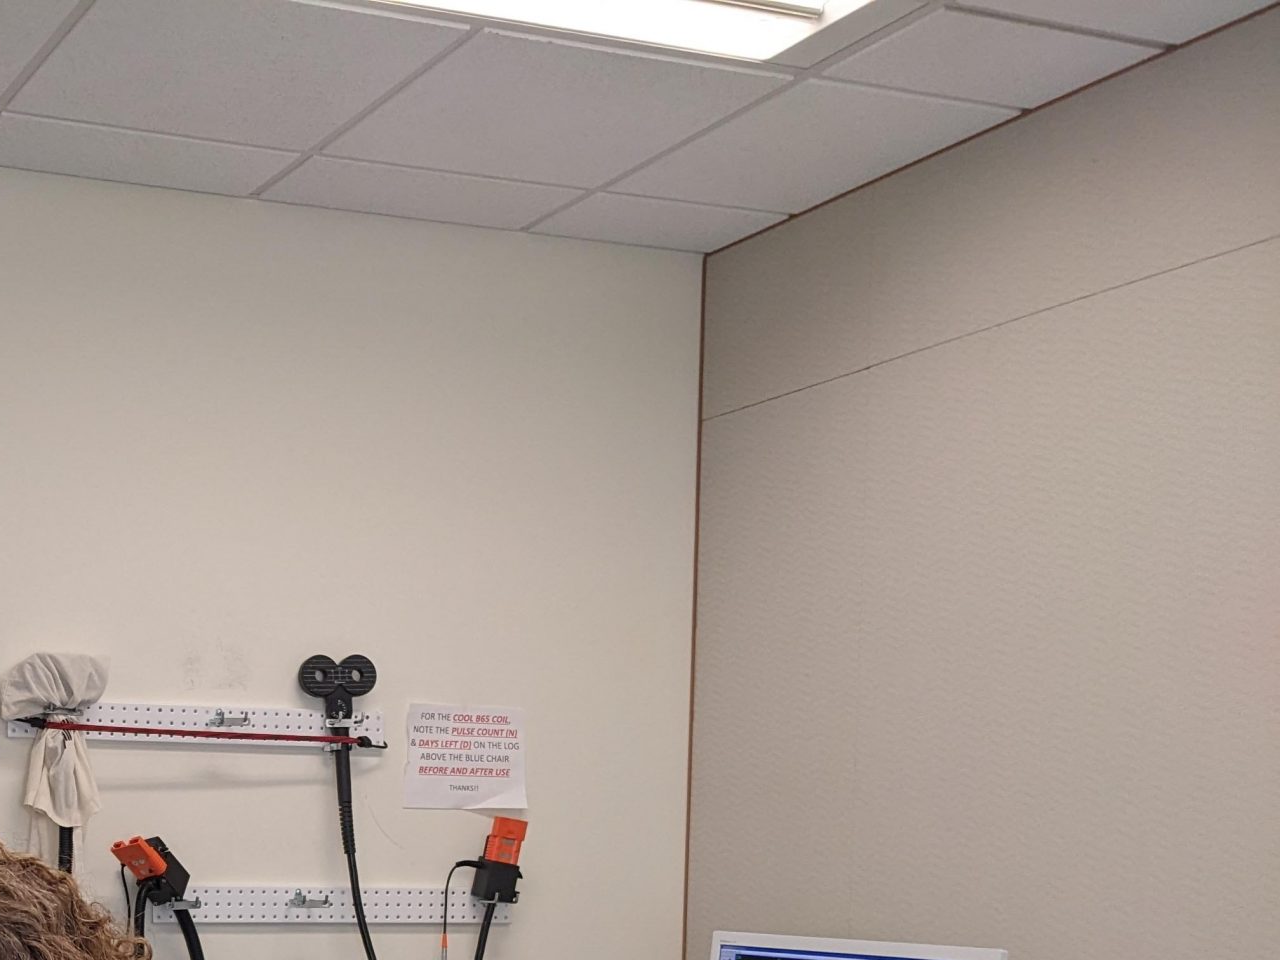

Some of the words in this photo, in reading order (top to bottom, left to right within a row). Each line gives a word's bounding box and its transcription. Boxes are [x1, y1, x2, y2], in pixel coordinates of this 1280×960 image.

[420, 712, 436, 721] FOR
[437, 713, 451, 721] THE
[452, 714, 474, 722] COOL
[491, 715, 511, 725] COIL,
[413, 725, 433, 734] NOTE
[435, 726, 450, 734] THE
[451, 727, 475, 736] PULSE
[476, 728, 504, 737] COUNT
[505, 728, 518, 738] (N)
[410, 738, 416, 747] &
[418, 739, 439, 748] DAYS
[440, 740, 459, 748] LEFT
[460, 740, 472, 750] (D)
[473, 741, 486, 749] ON
[487, 741, 502, 750] THE
[503, 742, 520, 750] LOG
[420, 752, 447, 761] ABOVE
[449, 753, 464, 762] THE
[465, 754, 485, 762] BLUE
[486, 755, 510, 763] CHAIR
[418, 766, 448, 775] BEFORE
[449, 767, 468, 775] AND
[469, 768, 493, 776] AFTER
[494, 768, 511, 776] USE
[449, 784, 479, 792] THANKS!!
